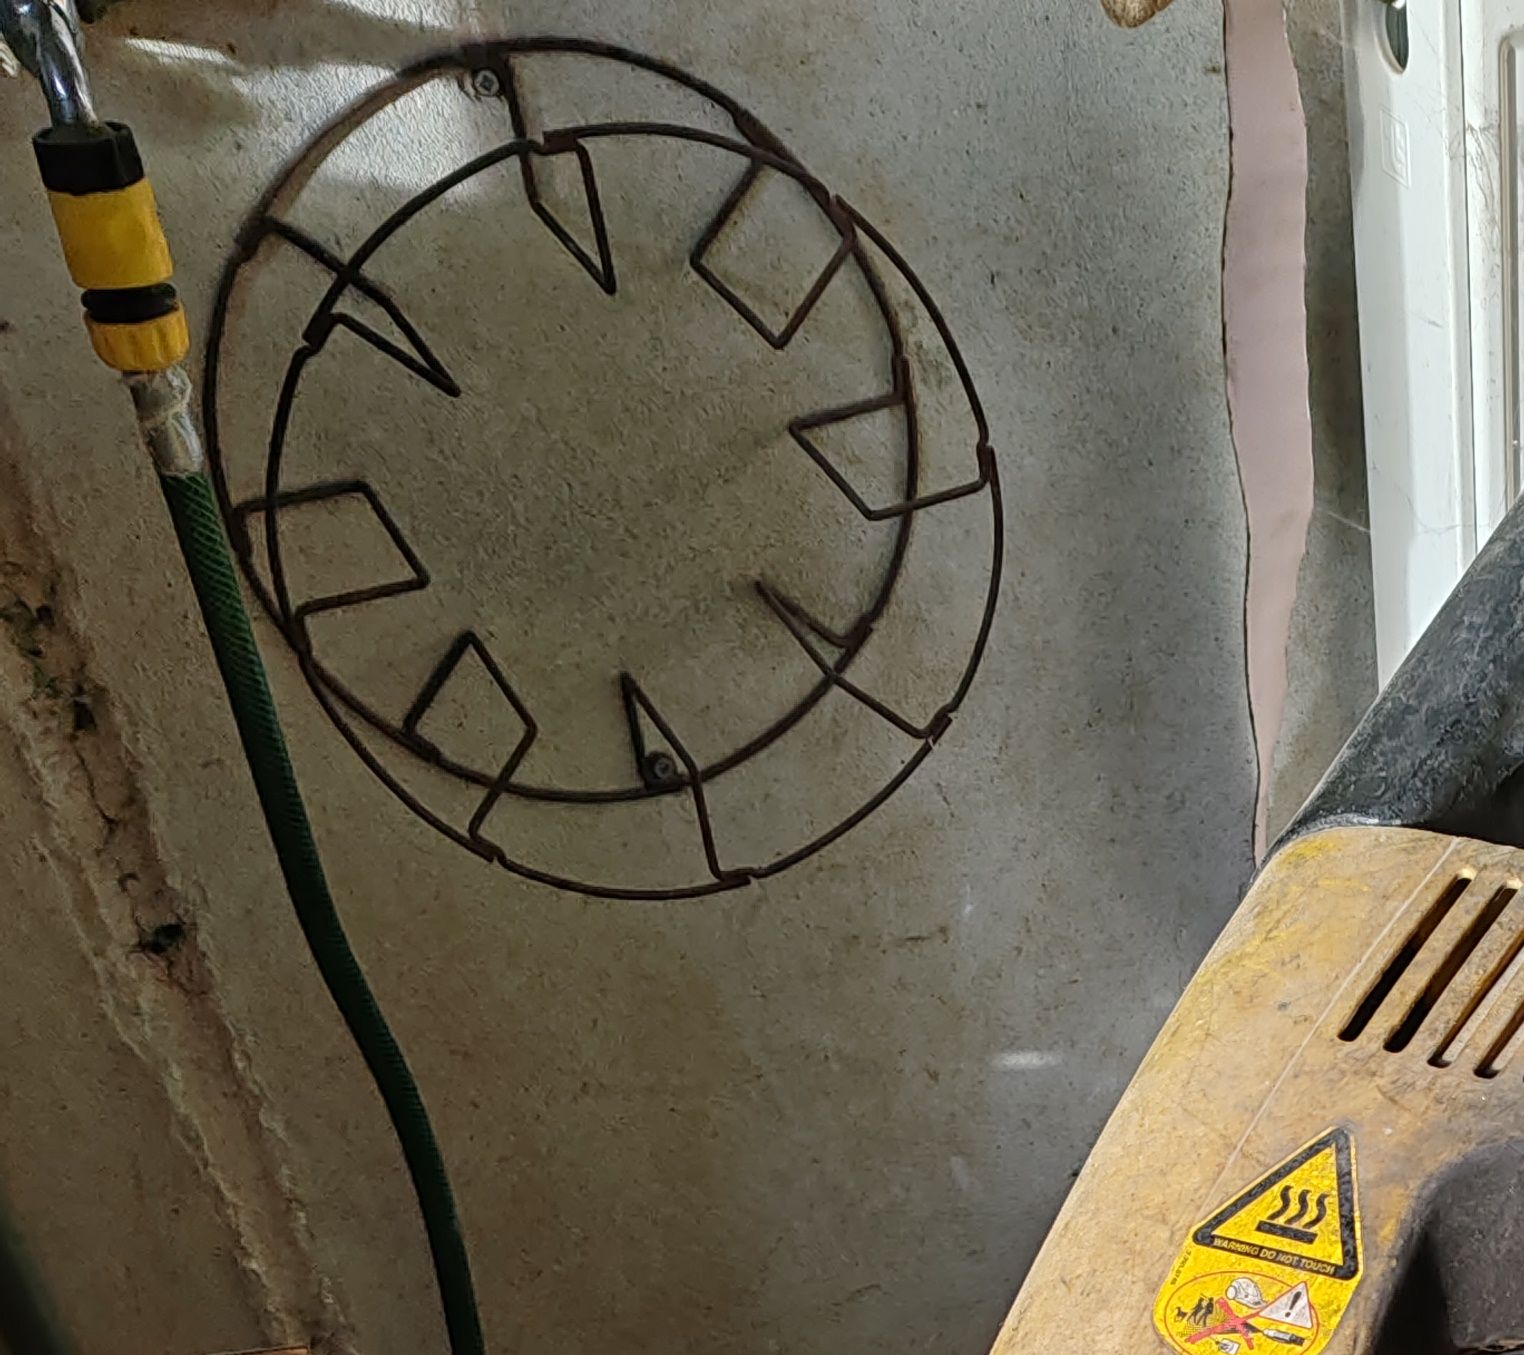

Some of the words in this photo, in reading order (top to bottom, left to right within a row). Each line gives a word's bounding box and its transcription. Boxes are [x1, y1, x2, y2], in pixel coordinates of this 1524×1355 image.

[1213, 1237, 1259, 1257] WARNING
[1259, 1249, 1276, 1261] DO
[1277, 1253, 1299, 1267] NOT
[1301, 1257, 1335, 1275] TOUCH
